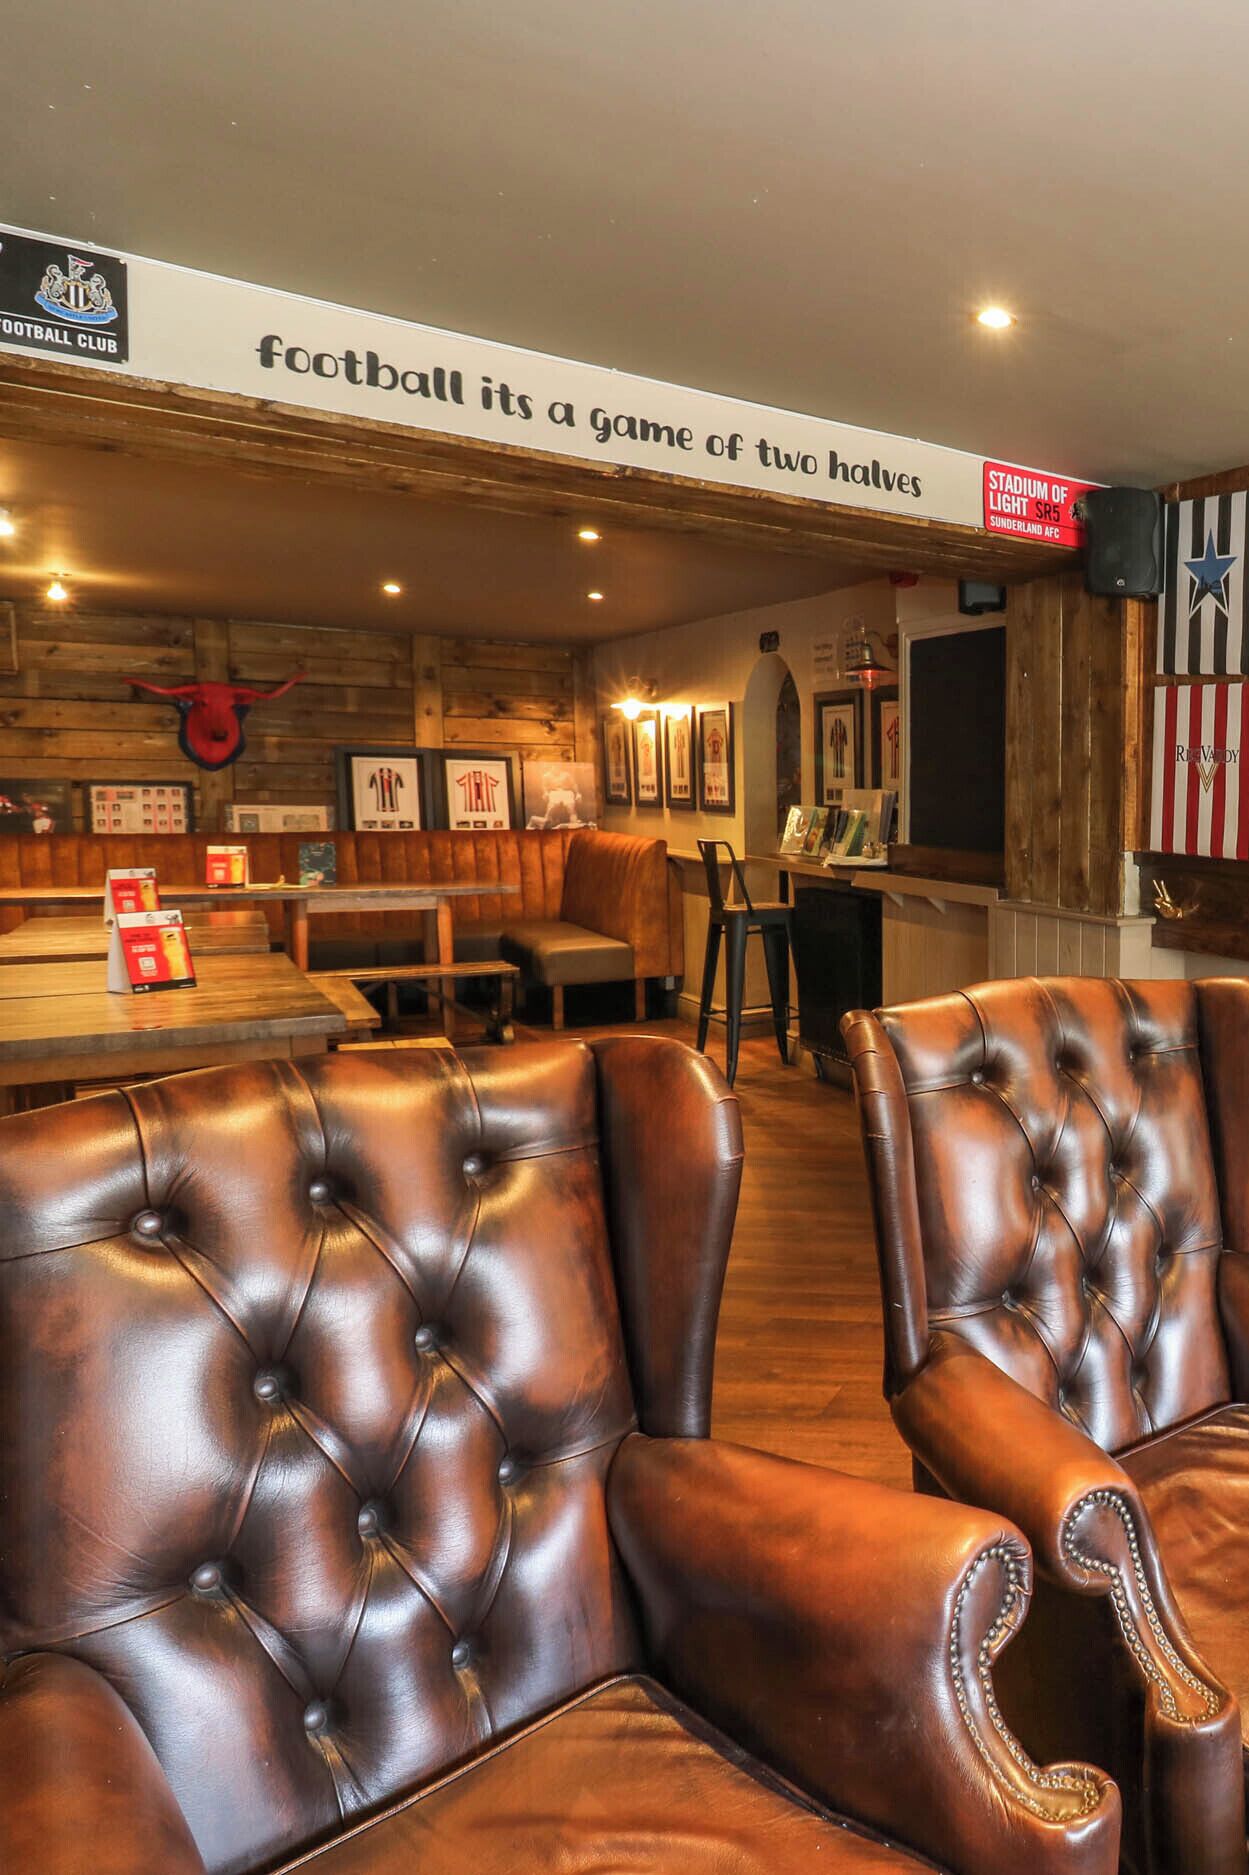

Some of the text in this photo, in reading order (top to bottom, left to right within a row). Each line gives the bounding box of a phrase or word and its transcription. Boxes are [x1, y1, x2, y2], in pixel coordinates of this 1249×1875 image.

[0, 318, 118, 353] OOTBALL CLUB
[255, 335, 922, 498] football its a game of two halves
[989, 470, 1068, 504] STADIUM OF
[989, 491, 1060, 522] LIGHT SR5
[990, 516, 1060, 539] SUNDERLAND AFC
